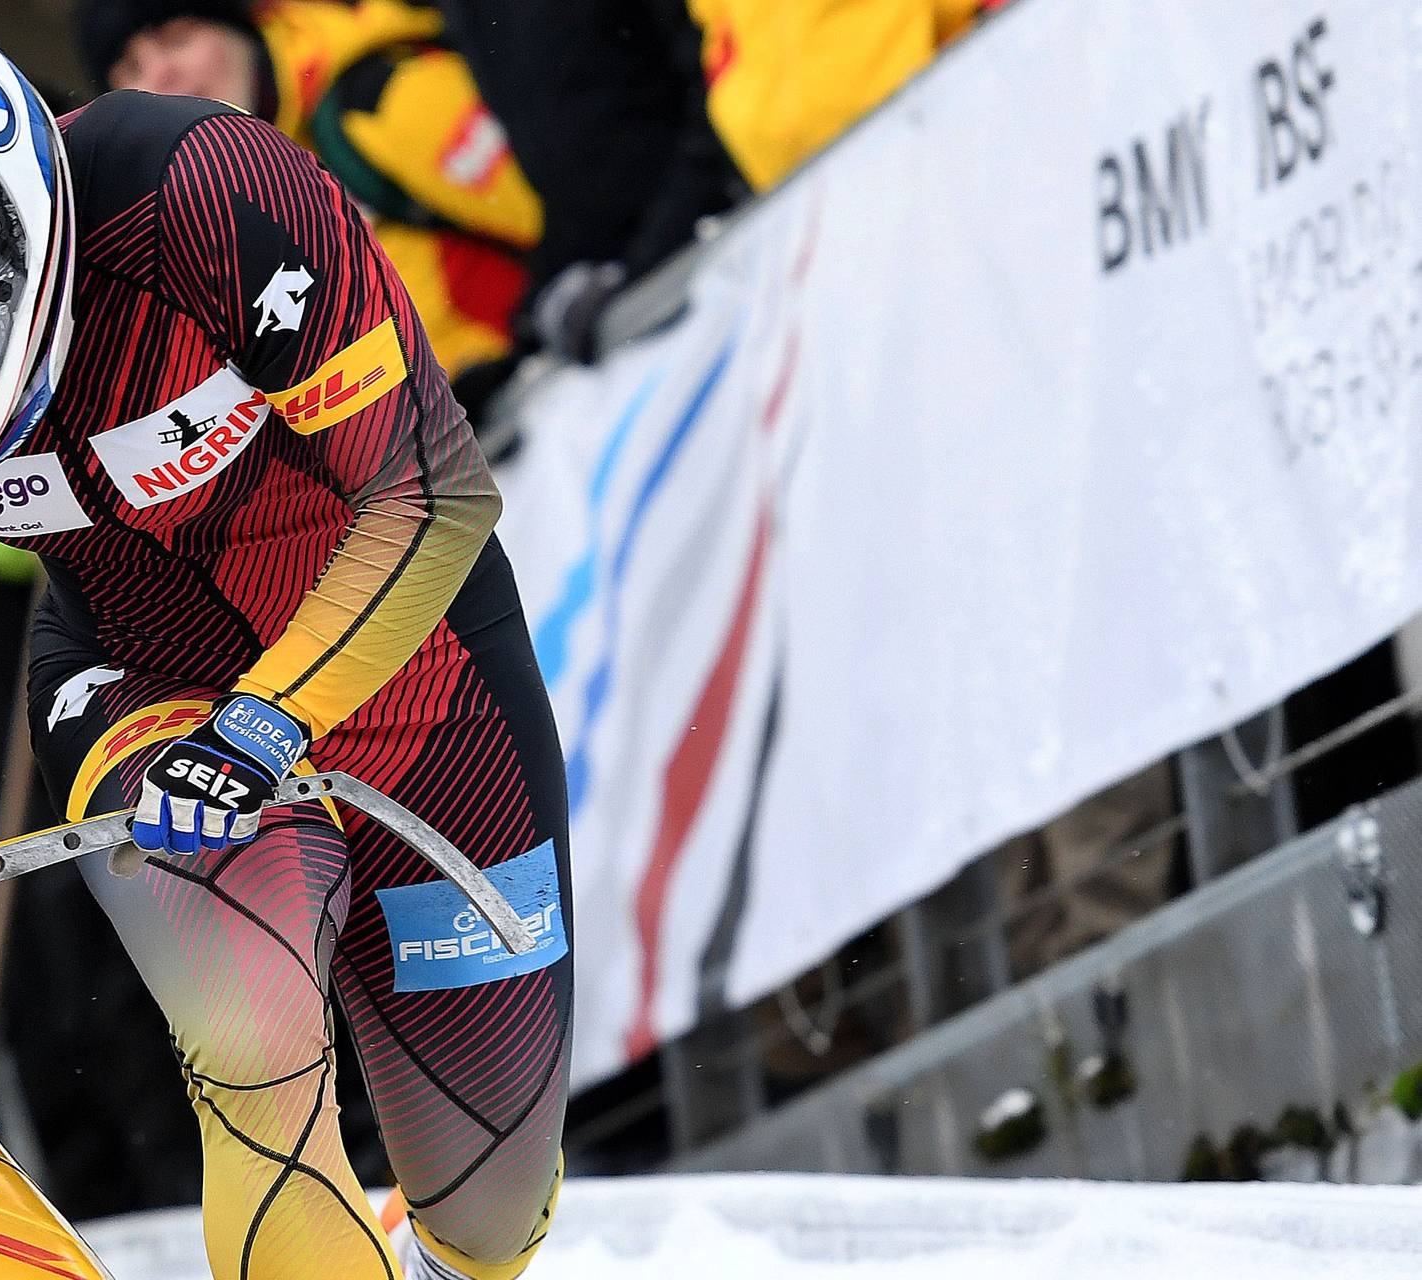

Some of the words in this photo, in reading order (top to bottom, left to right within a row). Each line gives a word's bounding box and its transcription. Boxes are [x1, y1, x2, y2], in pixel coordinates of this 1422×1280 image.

[132, 390, 272, 500] NIGRIN
[223, 718, 289, 770] Versicherung
[250, 717, 297, 762] IDEAL
